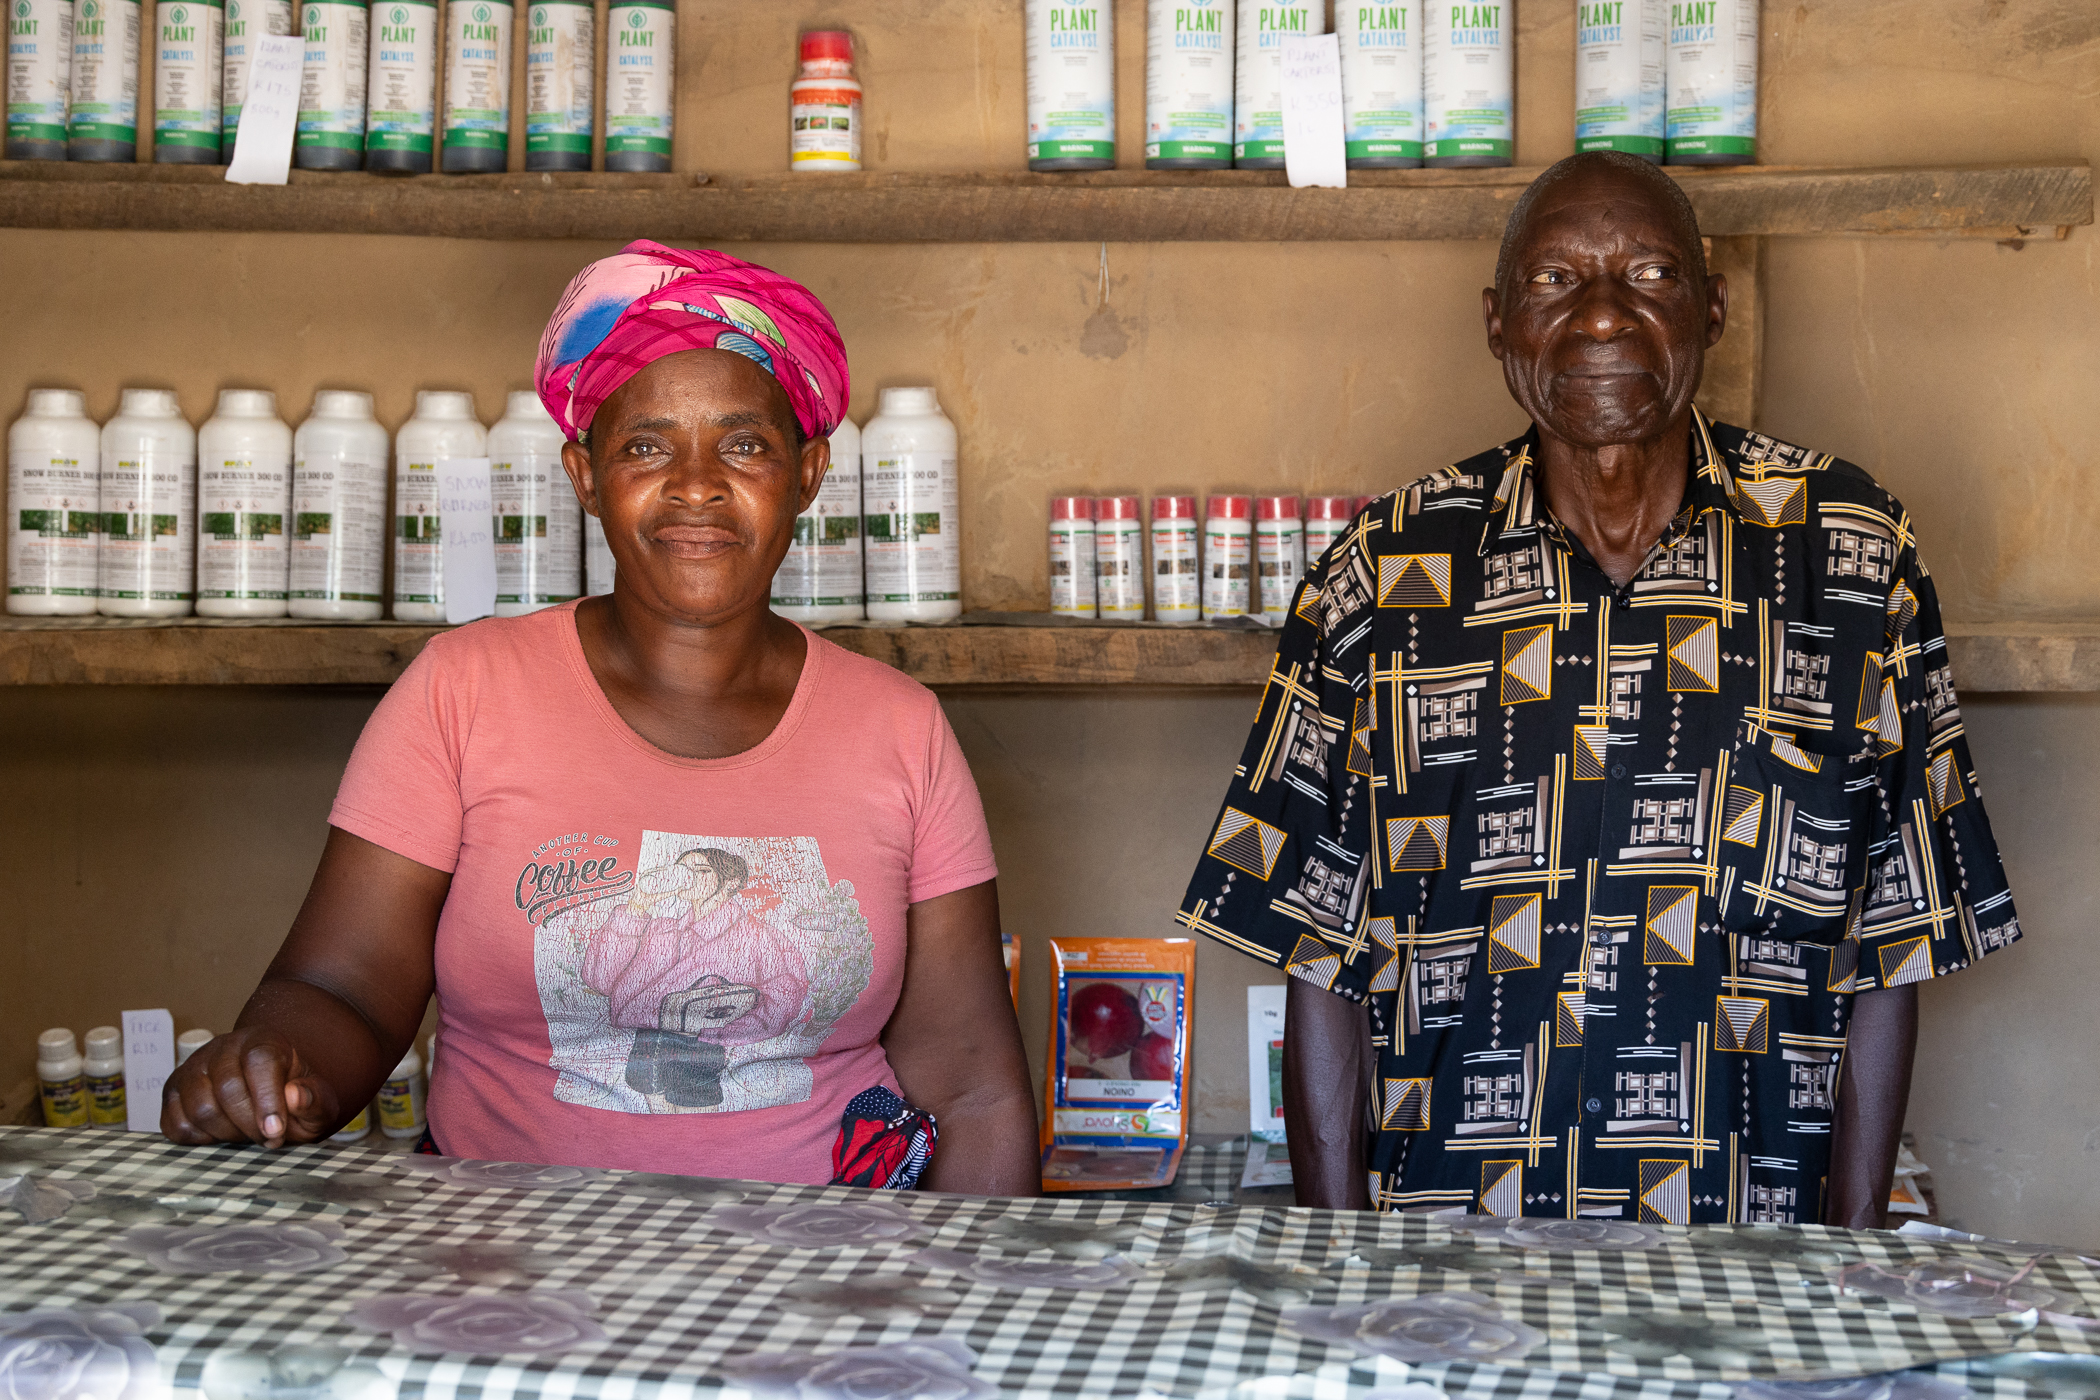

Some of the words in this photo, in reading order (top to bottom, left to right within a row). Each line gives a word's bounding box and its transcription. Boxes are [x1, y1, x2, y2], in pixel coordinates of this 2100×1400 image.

[1051, 9, 1097, 31] PLANT
[1176, 9, 1223, 32] PLANT
[1260, 8, 1308, 31] PLANT
[1359, 8, 1407, 31] PLANT
[1451, 6, 1500, 29] PLANT
[1580, 2, 1623, 29] PLANT
[1672, 2, 1716, 28] PLANT
[11, 20, 38, 35] PLANT
[76, 20, 105, 35] PLANT
[163, 26, 195, 41] PLANT
[381, 26, 415, 43] PLANT
[463, 24, 497, 41] PLANT
[1580, 26, 1622, 45] CATALYST
[1671, 26, 1715, 44] CATALYST
[620, 31, 654, 47] PLANT
[1051, 33, 1097, 47] CATALYST
[1175, 33, 1222, 49] CATALYST
[1359, 32, 1406, 47] CATALYST
[1451, 30, 1500, 45] CATALYST
[162, 50, 195, 61] CATALYST
[380, 51, 415, 62] CATALYST
[463, 48, 497, 60] CATALYST
[619, 55, 653, 66] CATALYST
[532, 832, 588, 859] ANOTHER
[594, 835, 619, 847] CUP
[515, 857, 630, 911] Coffee
[1103, 1087, 1135, 1097] ONION
